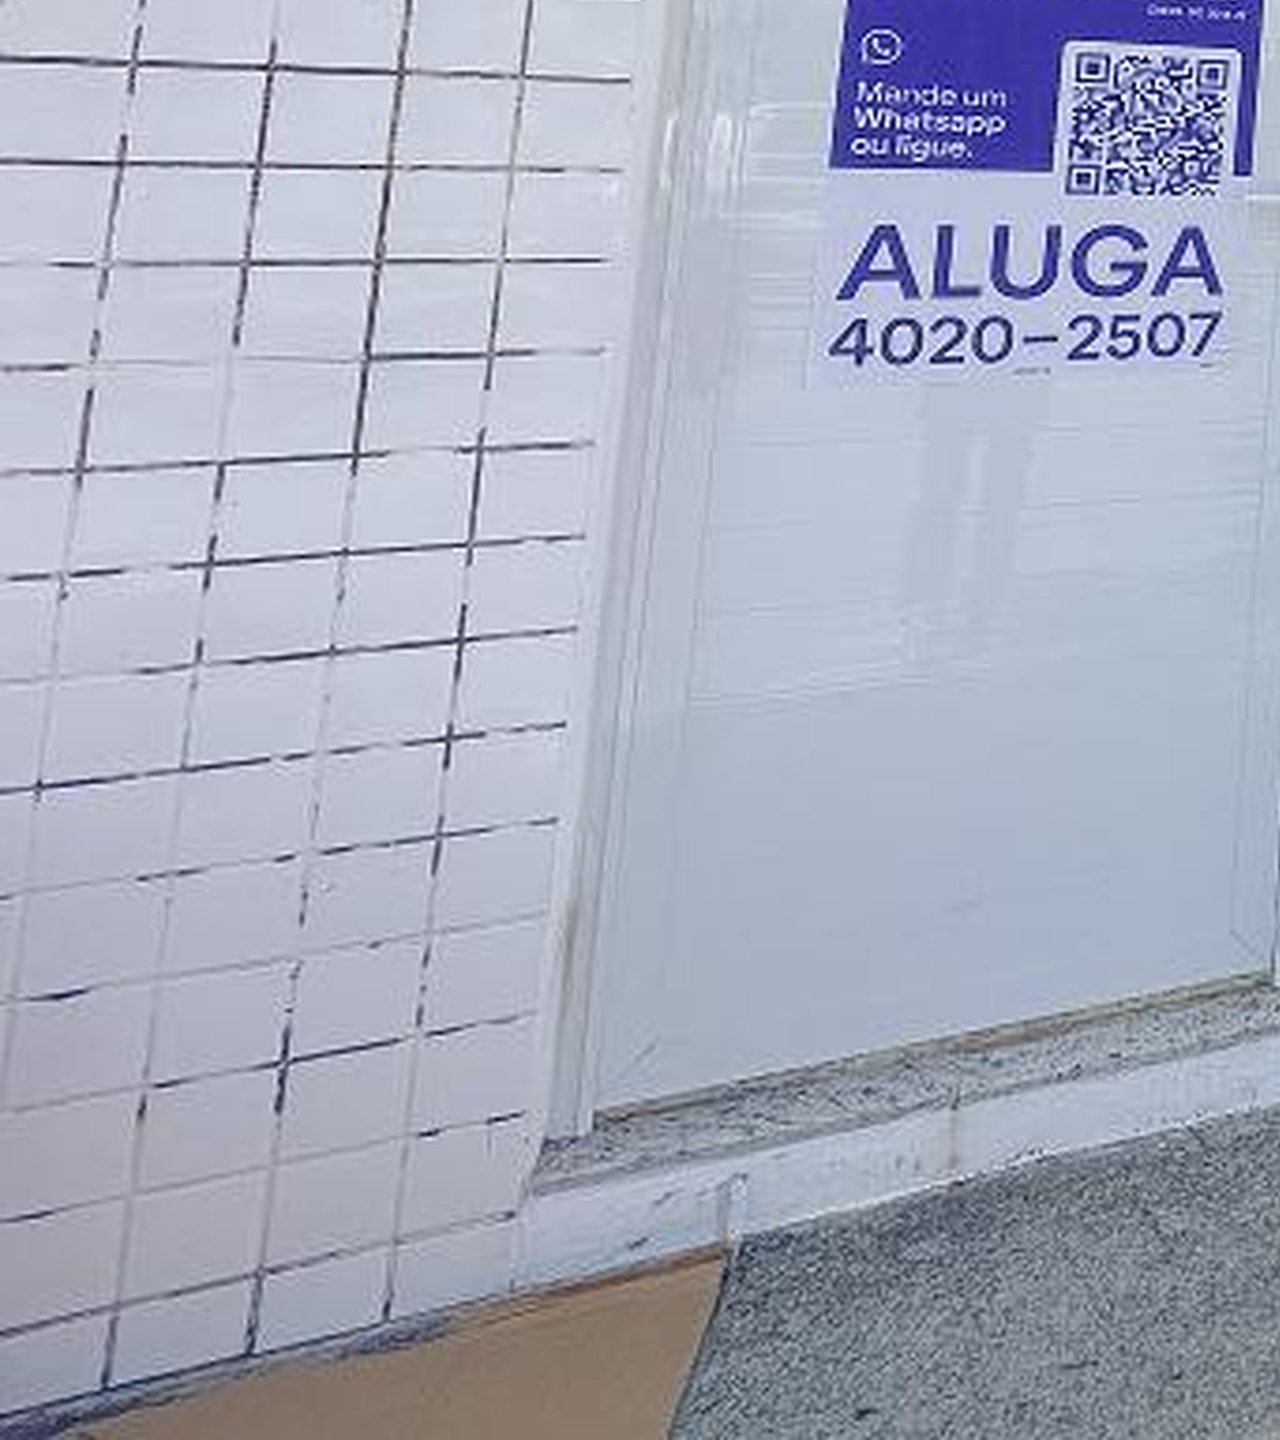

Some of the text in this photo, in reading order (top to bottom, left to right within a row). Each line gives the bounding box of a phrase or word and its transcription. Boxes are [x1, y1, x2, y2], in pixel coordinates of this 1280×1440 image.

[856, 80, 1007, 108] Mande um
[853, 105, 1007, 137] Whatsapp
[850, 137, 889, 156] ou
[835, 223, 1224, 301] ALUGA
[827, 310, 1225, 367] 4020-2507
